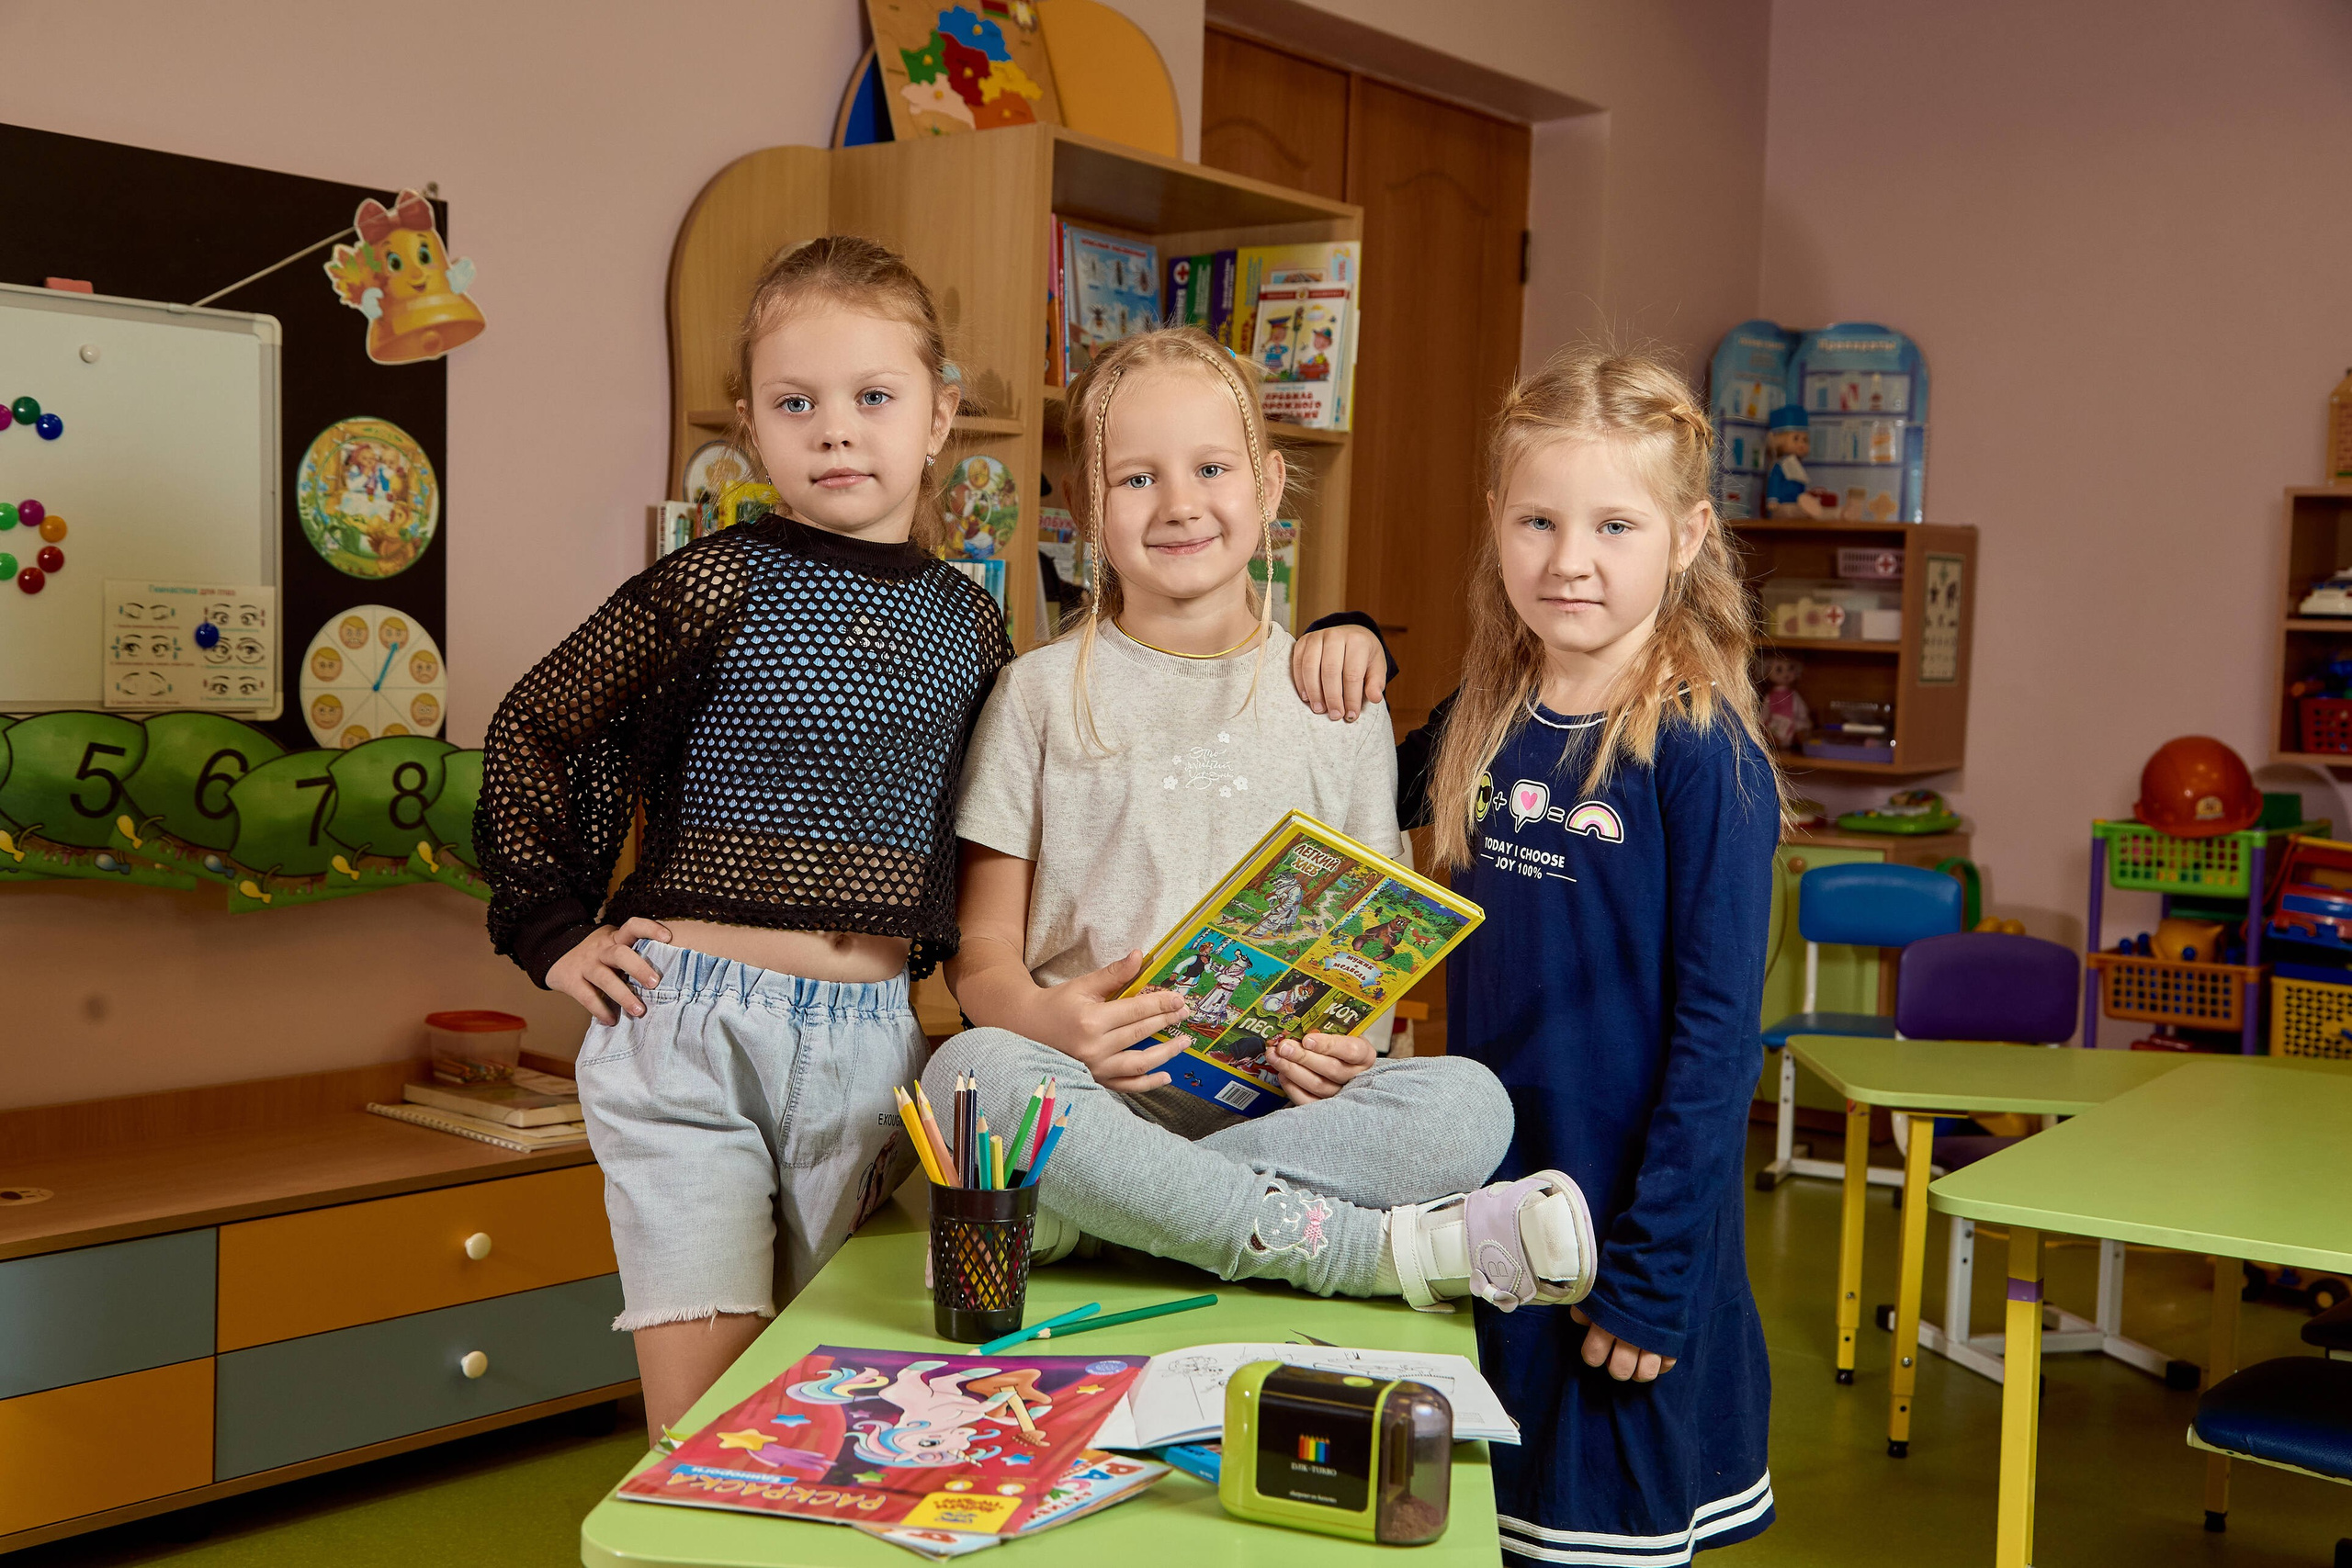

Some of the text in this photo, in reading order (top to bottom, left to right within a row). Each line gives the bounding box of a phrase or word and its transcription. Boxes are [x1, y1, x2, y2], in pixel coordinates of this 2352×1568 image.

[1261, 400, 1322, 409] ОРОЖНОГО
[69, 741, 429, 847] 5 6 7 8
[1294, 844, 1340, 871] ЛЕГКИЙ
[1484, 836, 1566, 869] TODAY I CHOOSE
[1292, 857, 1321, 876] ХЛЕБ
[1495, 855, 1543, 879] JOY 100%
[1324, 1002, 1360, 1024] КОТ
[1238, 1017, 1275, 1039] ПЕС
[666, 1472, 887, 1511] РАСКРАСКА
